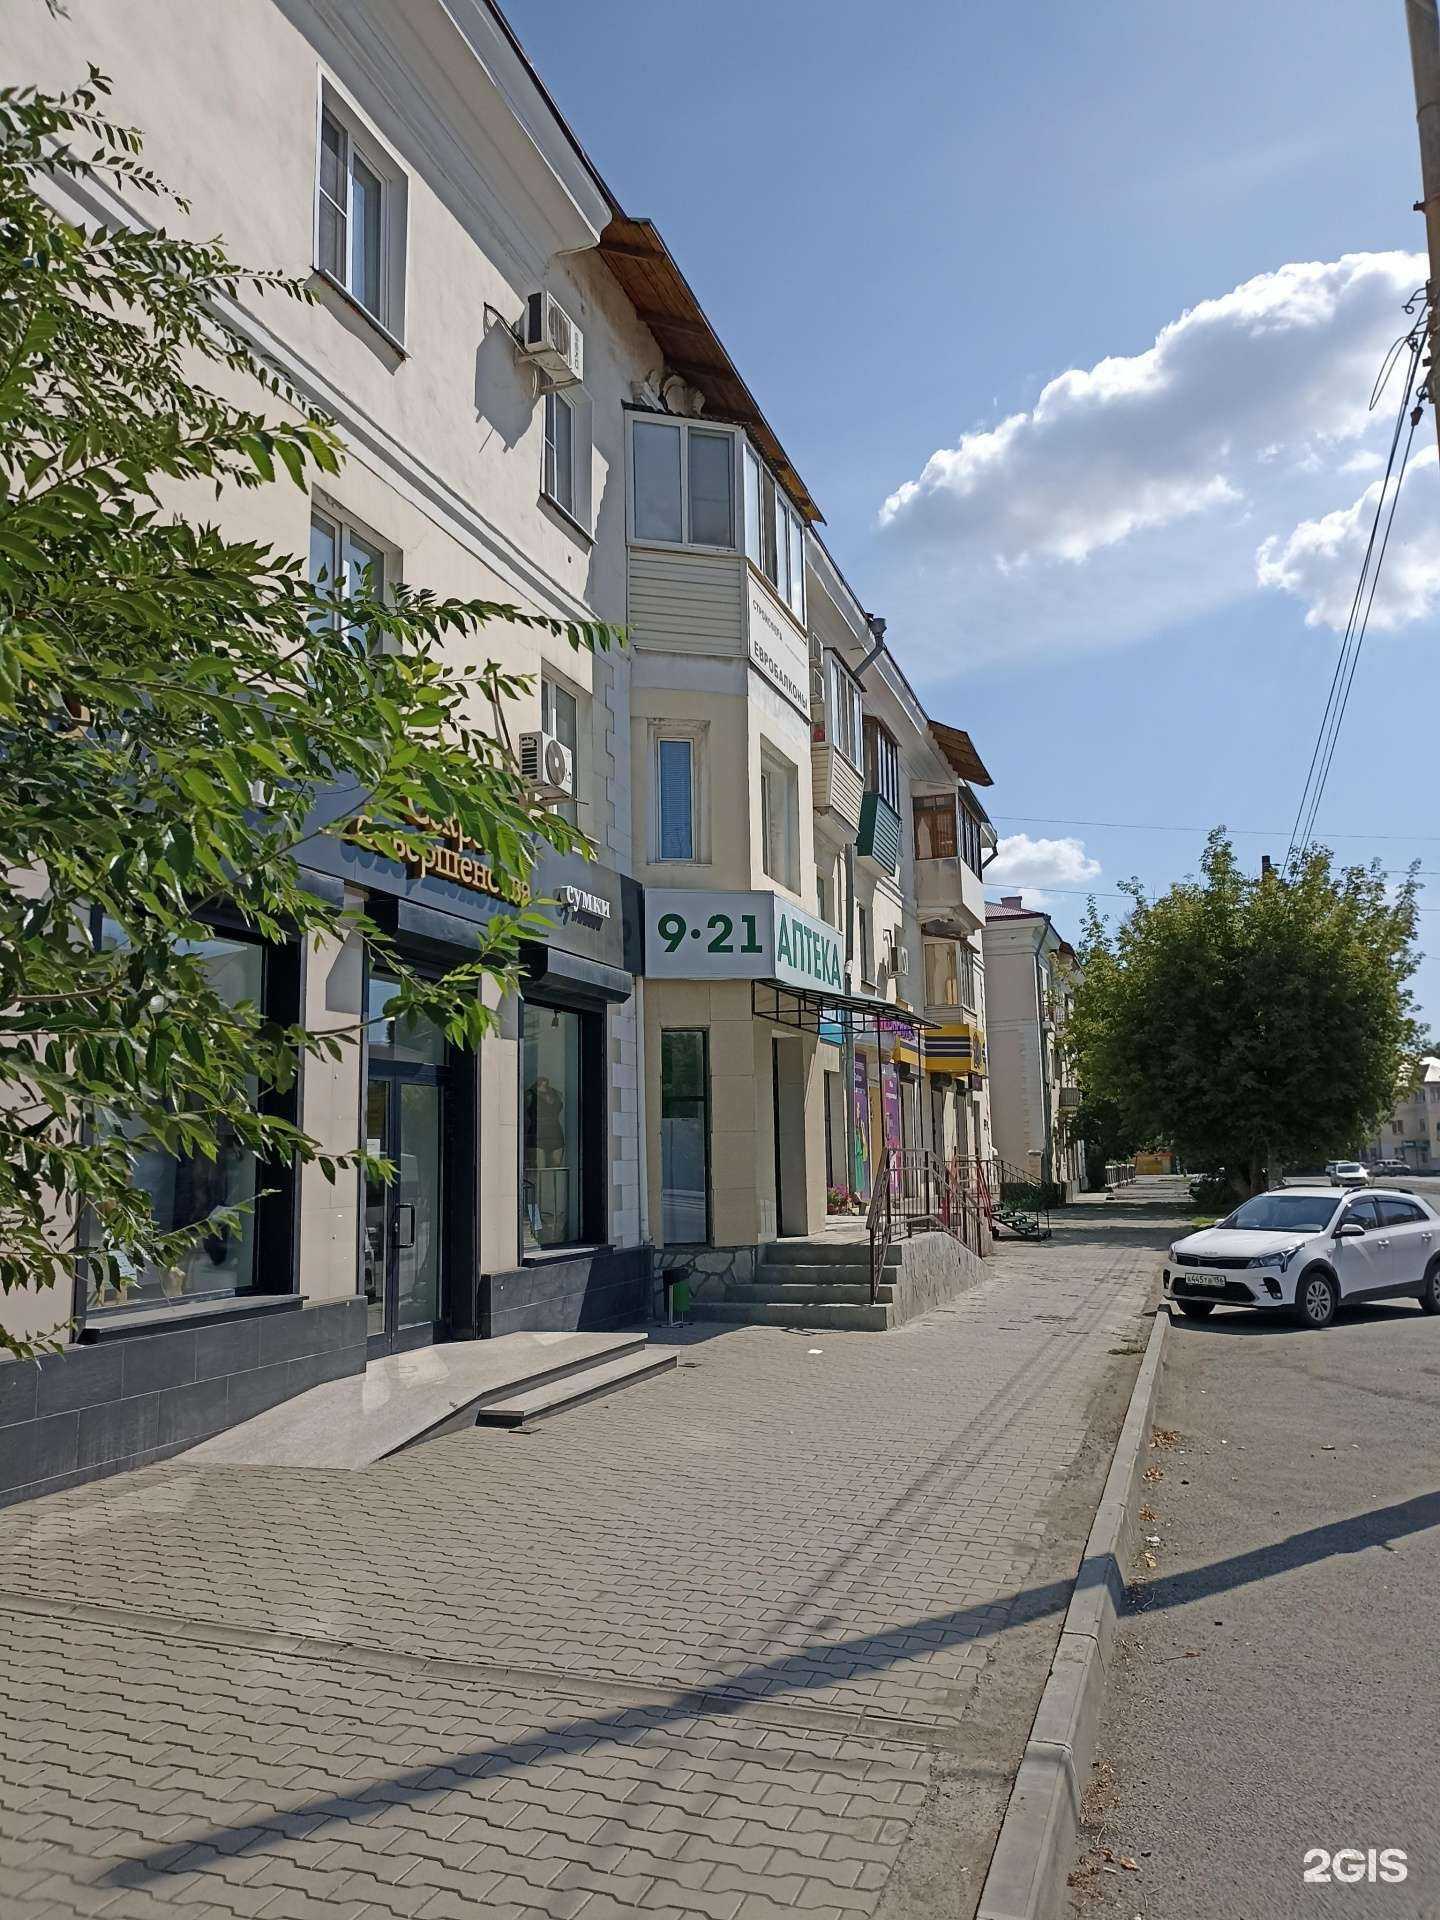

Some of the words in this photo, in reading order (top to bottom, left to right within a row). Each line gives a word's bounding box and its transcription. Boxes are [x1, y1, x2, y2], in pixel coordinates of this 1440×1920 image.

[754, 640, 808, 710] ЕВРОБАЛКОНЫ
[356, 814, 532, 904] Свершенсва
[566, 885, 611, 919] сумки
[777, 913, 842, 990] АПТЕКА
